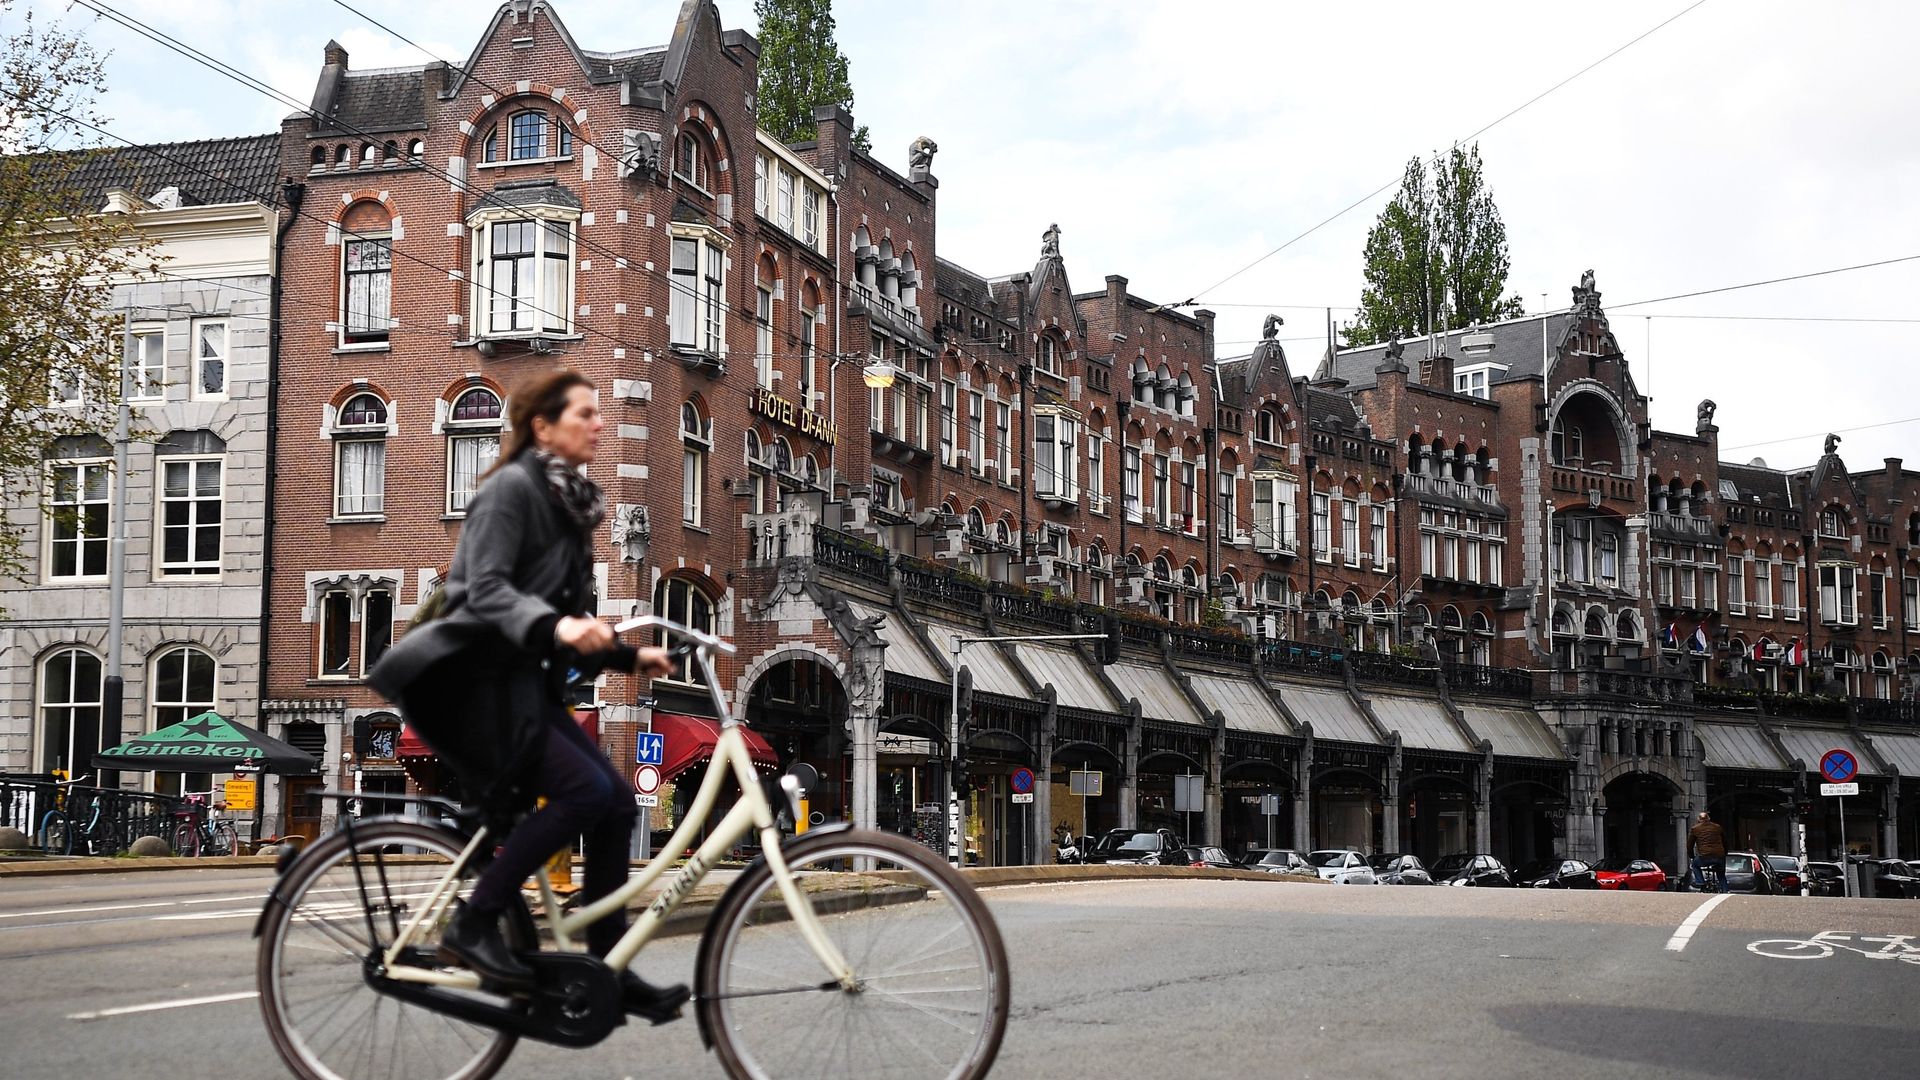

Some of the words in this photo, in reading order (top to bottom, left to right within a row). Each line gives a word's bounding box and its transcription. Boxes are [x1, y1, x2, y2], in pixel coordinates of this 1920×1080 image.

[758, 388, 797, 428] HOTEL
[801, 408, 839, 446] DI-ANN
[652, 855, 705, 916] SPIRIT
